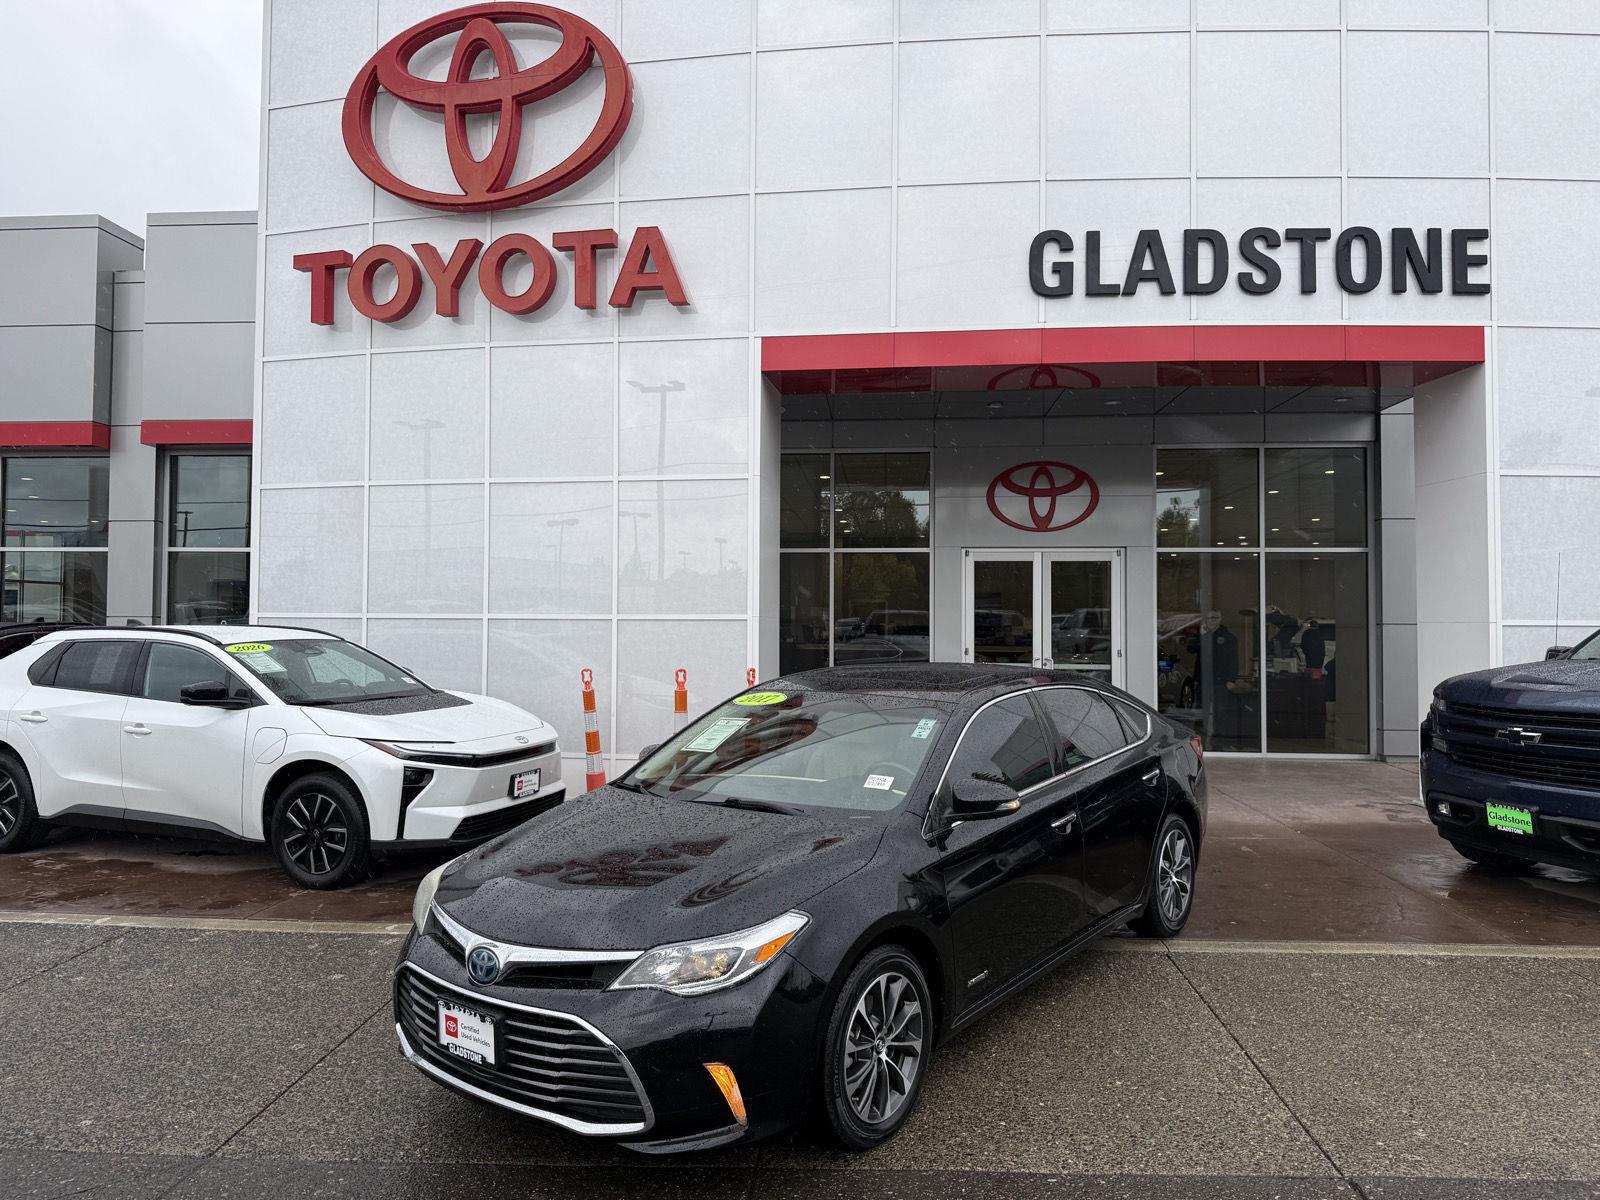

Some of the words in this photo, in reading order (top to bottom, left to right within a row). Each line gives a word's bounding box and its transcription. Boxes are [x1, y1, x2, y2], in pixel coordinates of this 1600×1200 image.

[1029, 226, 1491, 297] GLADSTONE
[293, 226, 690, 325] TOYOTA
[234, 644, 265, 652] 2026
[1488, 811, 1532, 827] Gladstone
[449, 1003, 481, 1019] TOYOTA
[460, 1022, 480, 1035] Certified
[460, 1032, 473, 1041] Used
[472, 1036, 491, 1048] Vehicles
[448, 1043, 483, 1064] GLADSTONE
